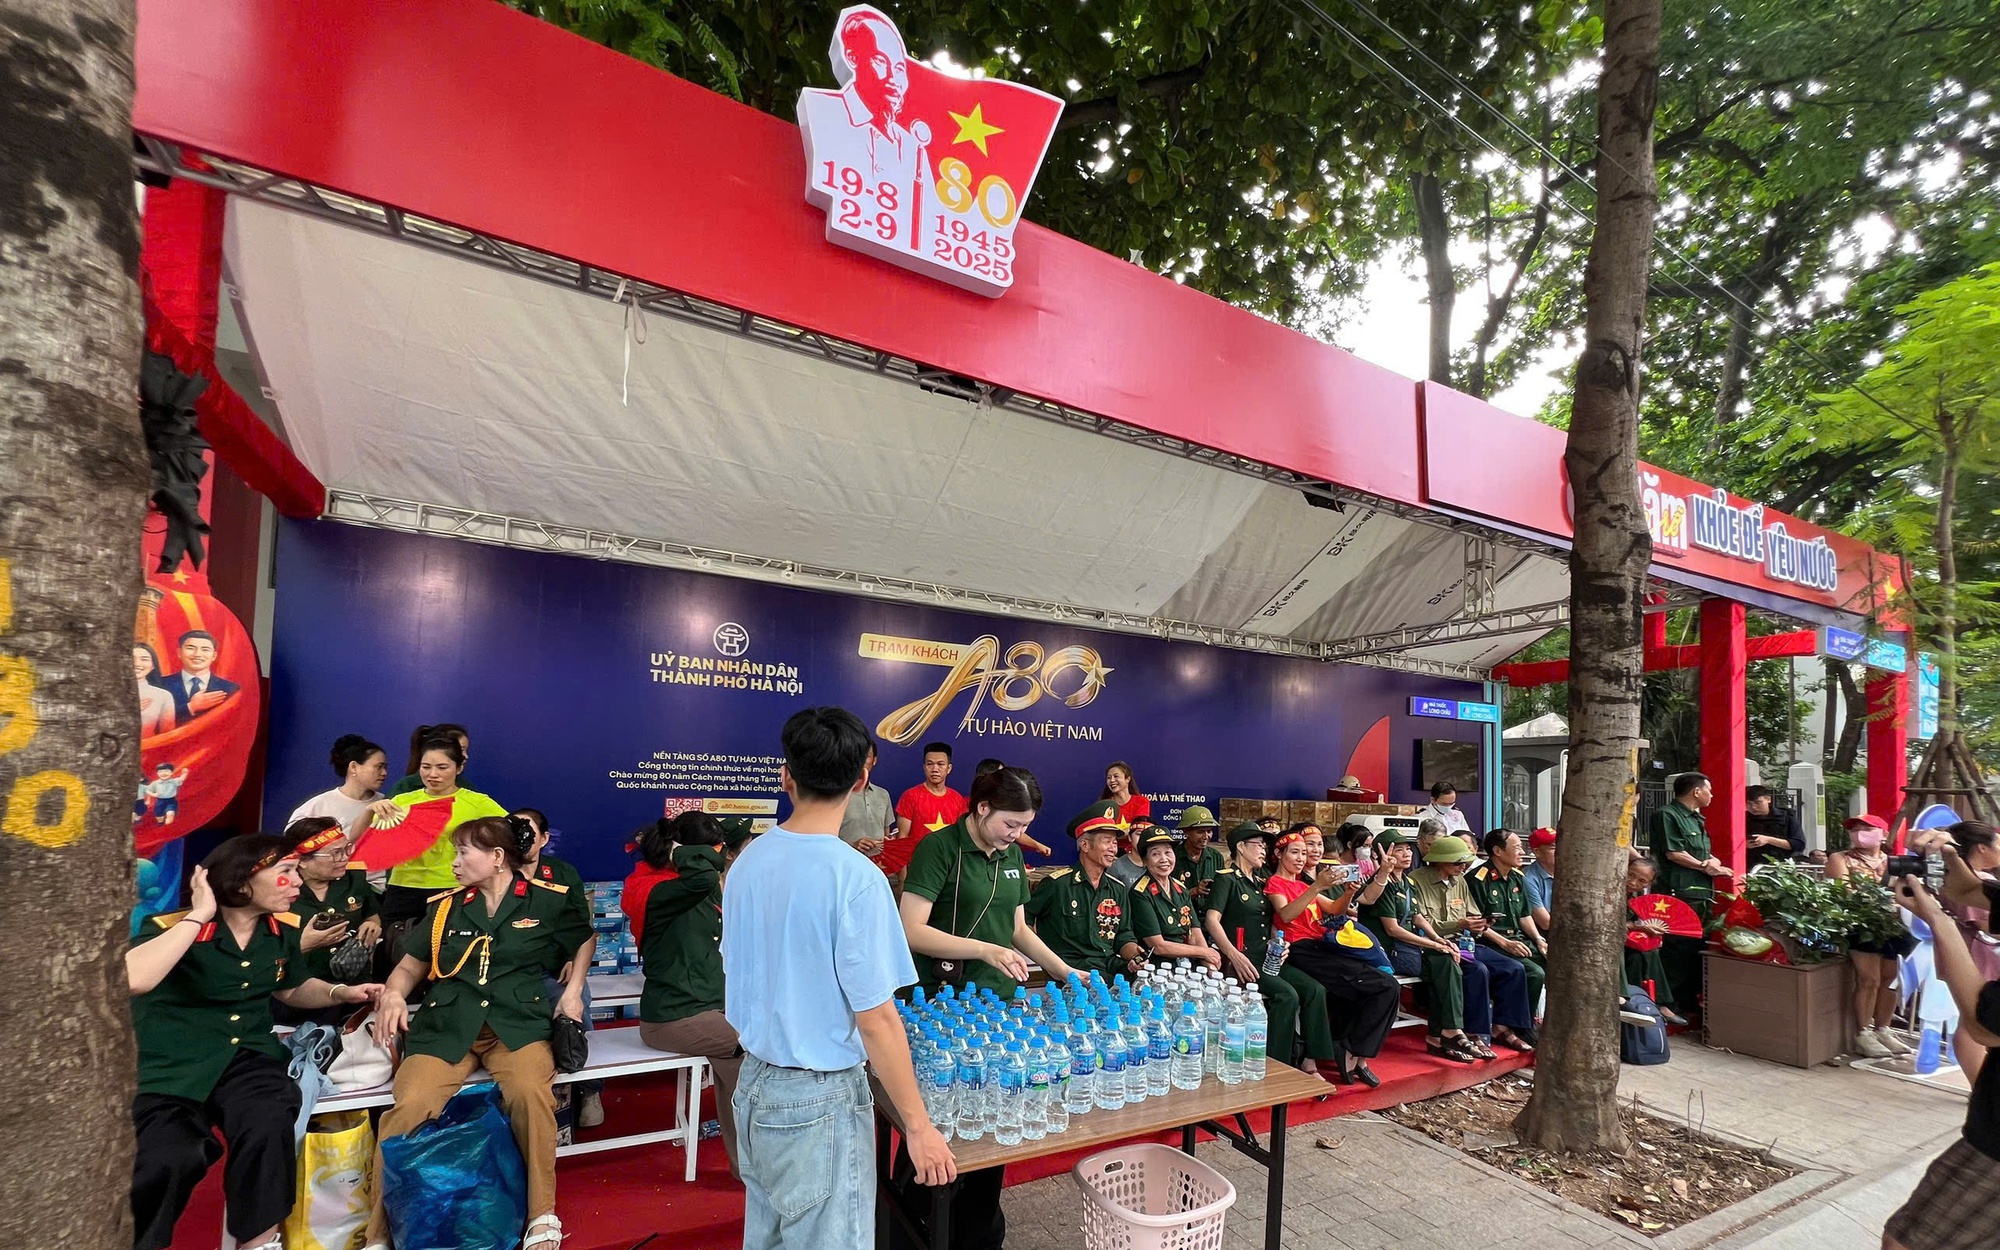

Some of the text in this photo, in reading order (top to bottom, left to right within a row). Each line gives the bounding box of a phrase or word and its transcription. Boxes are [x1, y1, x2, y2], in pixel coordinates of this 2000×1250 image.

[822, 160, 898, 212] 19-8
[936, 157, 1016, 229] 80
[839, 198, 898, 240] 2-9
[935, 215, 1011, 259] 1945
[934, 238, 1010, 282] 2025
[1693, 488, 1740, 556] KHỎE
[1741, 503, 1765, 561] ĐỂ
[1767, 522, 1798, 581] YÊU
[1798, 535, 1837, 592] NƯỚC
[651, 651, 798, 679] UỶ BAN NHÂN DÂN
[912, 645, 959, 660] KHÁCH
[650, 668, 803, 697] THÀNH PHỐ HÀ NỘI
[966, 716, 1103, 741] TỰ HÀO VIỆT NAM
[710, 754, 727, 762] A80
[758, 756, 776, 765] VIỆT
[659, 772, 671, 780] 80
[1158, 792, 1170, 802] VÀ
[1170, 792, 1185, 803] THỂ
[1185, 794, 1206, 803] THAO
